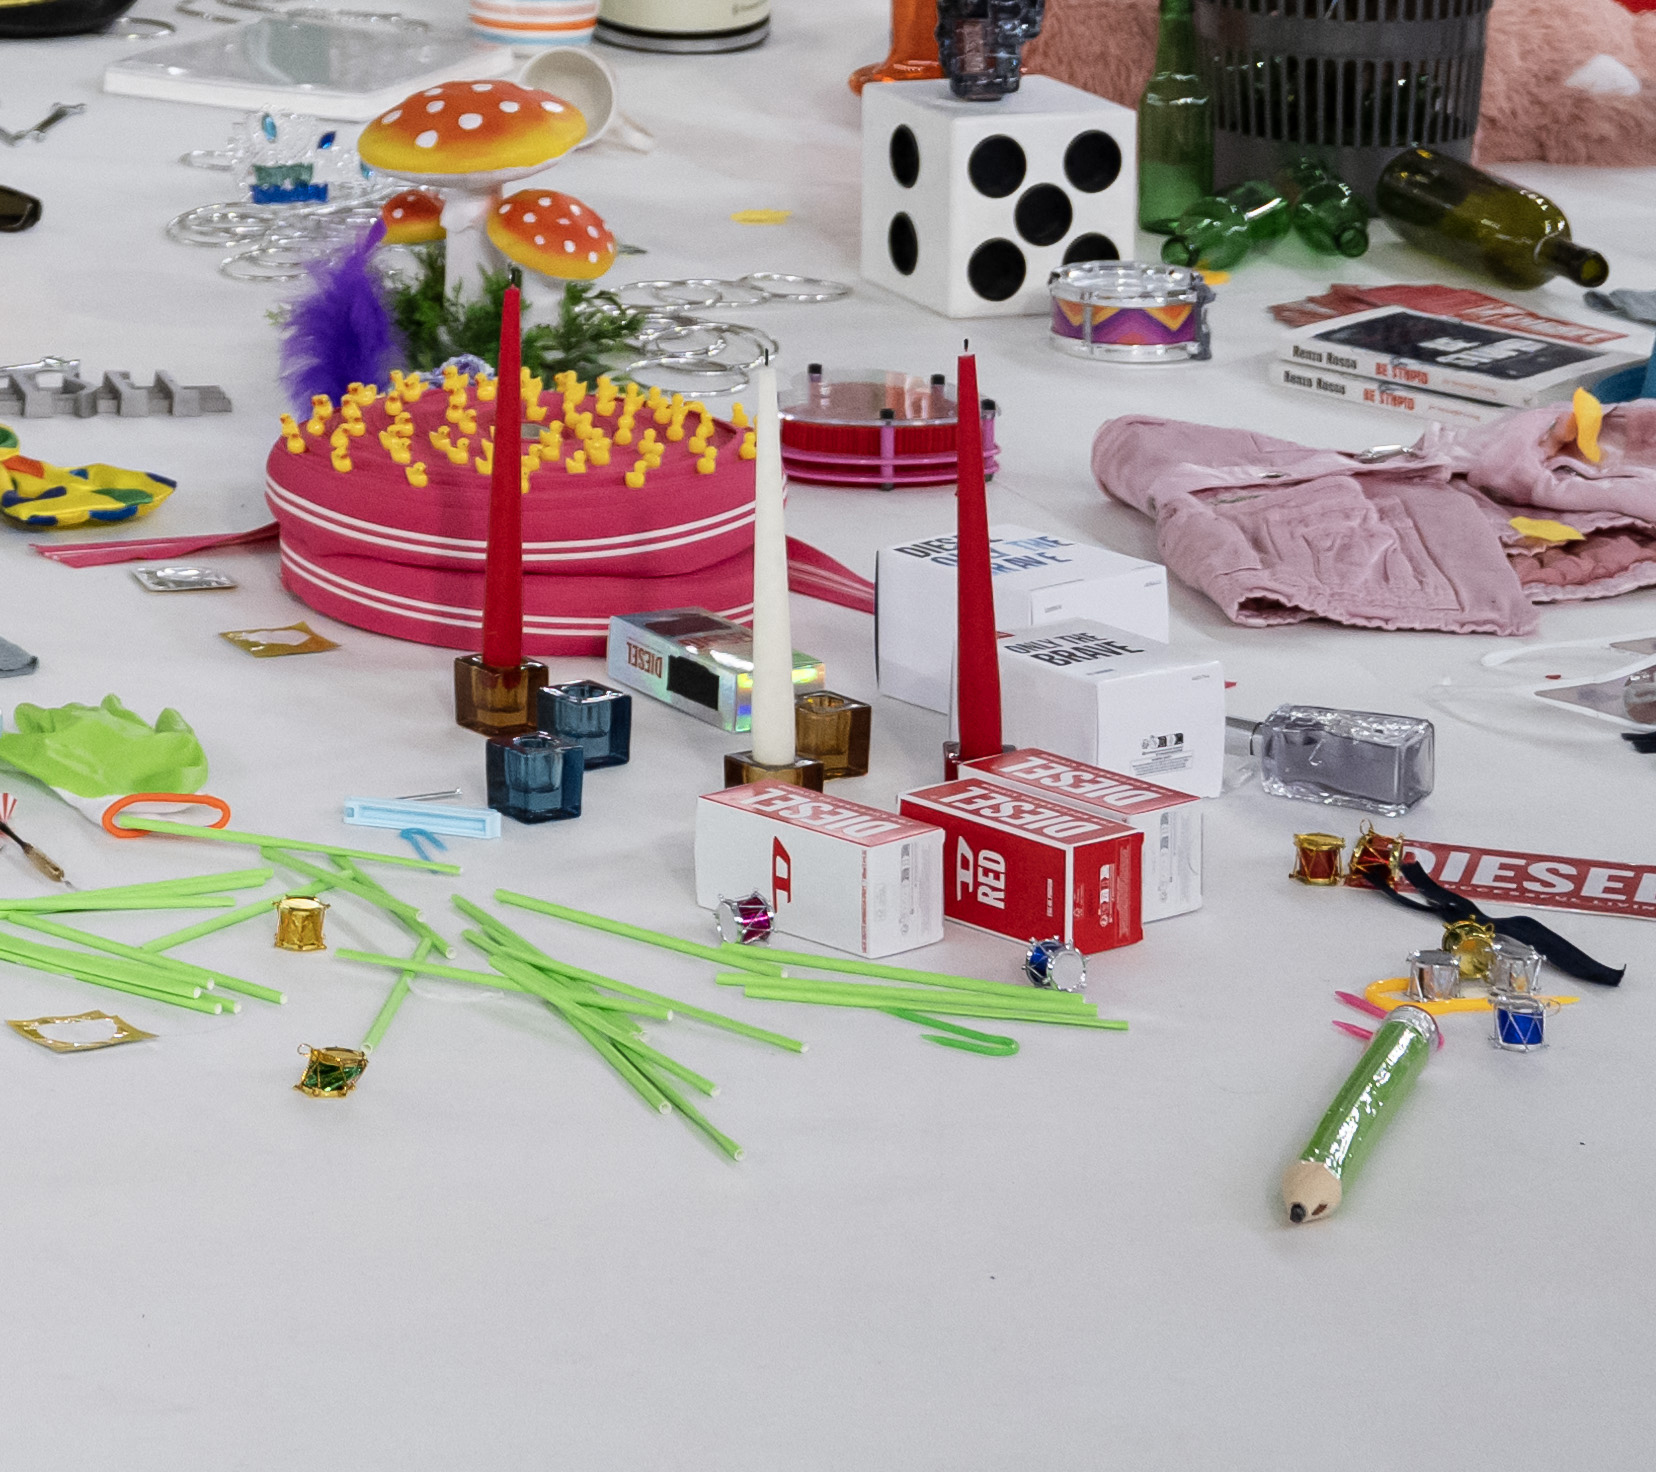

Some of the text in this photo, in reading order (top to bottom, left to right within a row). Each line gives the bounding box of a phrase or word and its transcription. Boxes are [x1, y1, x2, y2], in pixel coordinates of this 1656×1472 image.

[1003, 631, 1109, 655] ONLY THE
[1032, 639, 1146, 668] BRAVE
[998, 756, 1164, 806] DIESEL
[739, 787, 902, 839] DIESEL
[938, 786, 1105, 838] DIESEL
[976, 849, 1006, 910] RED
